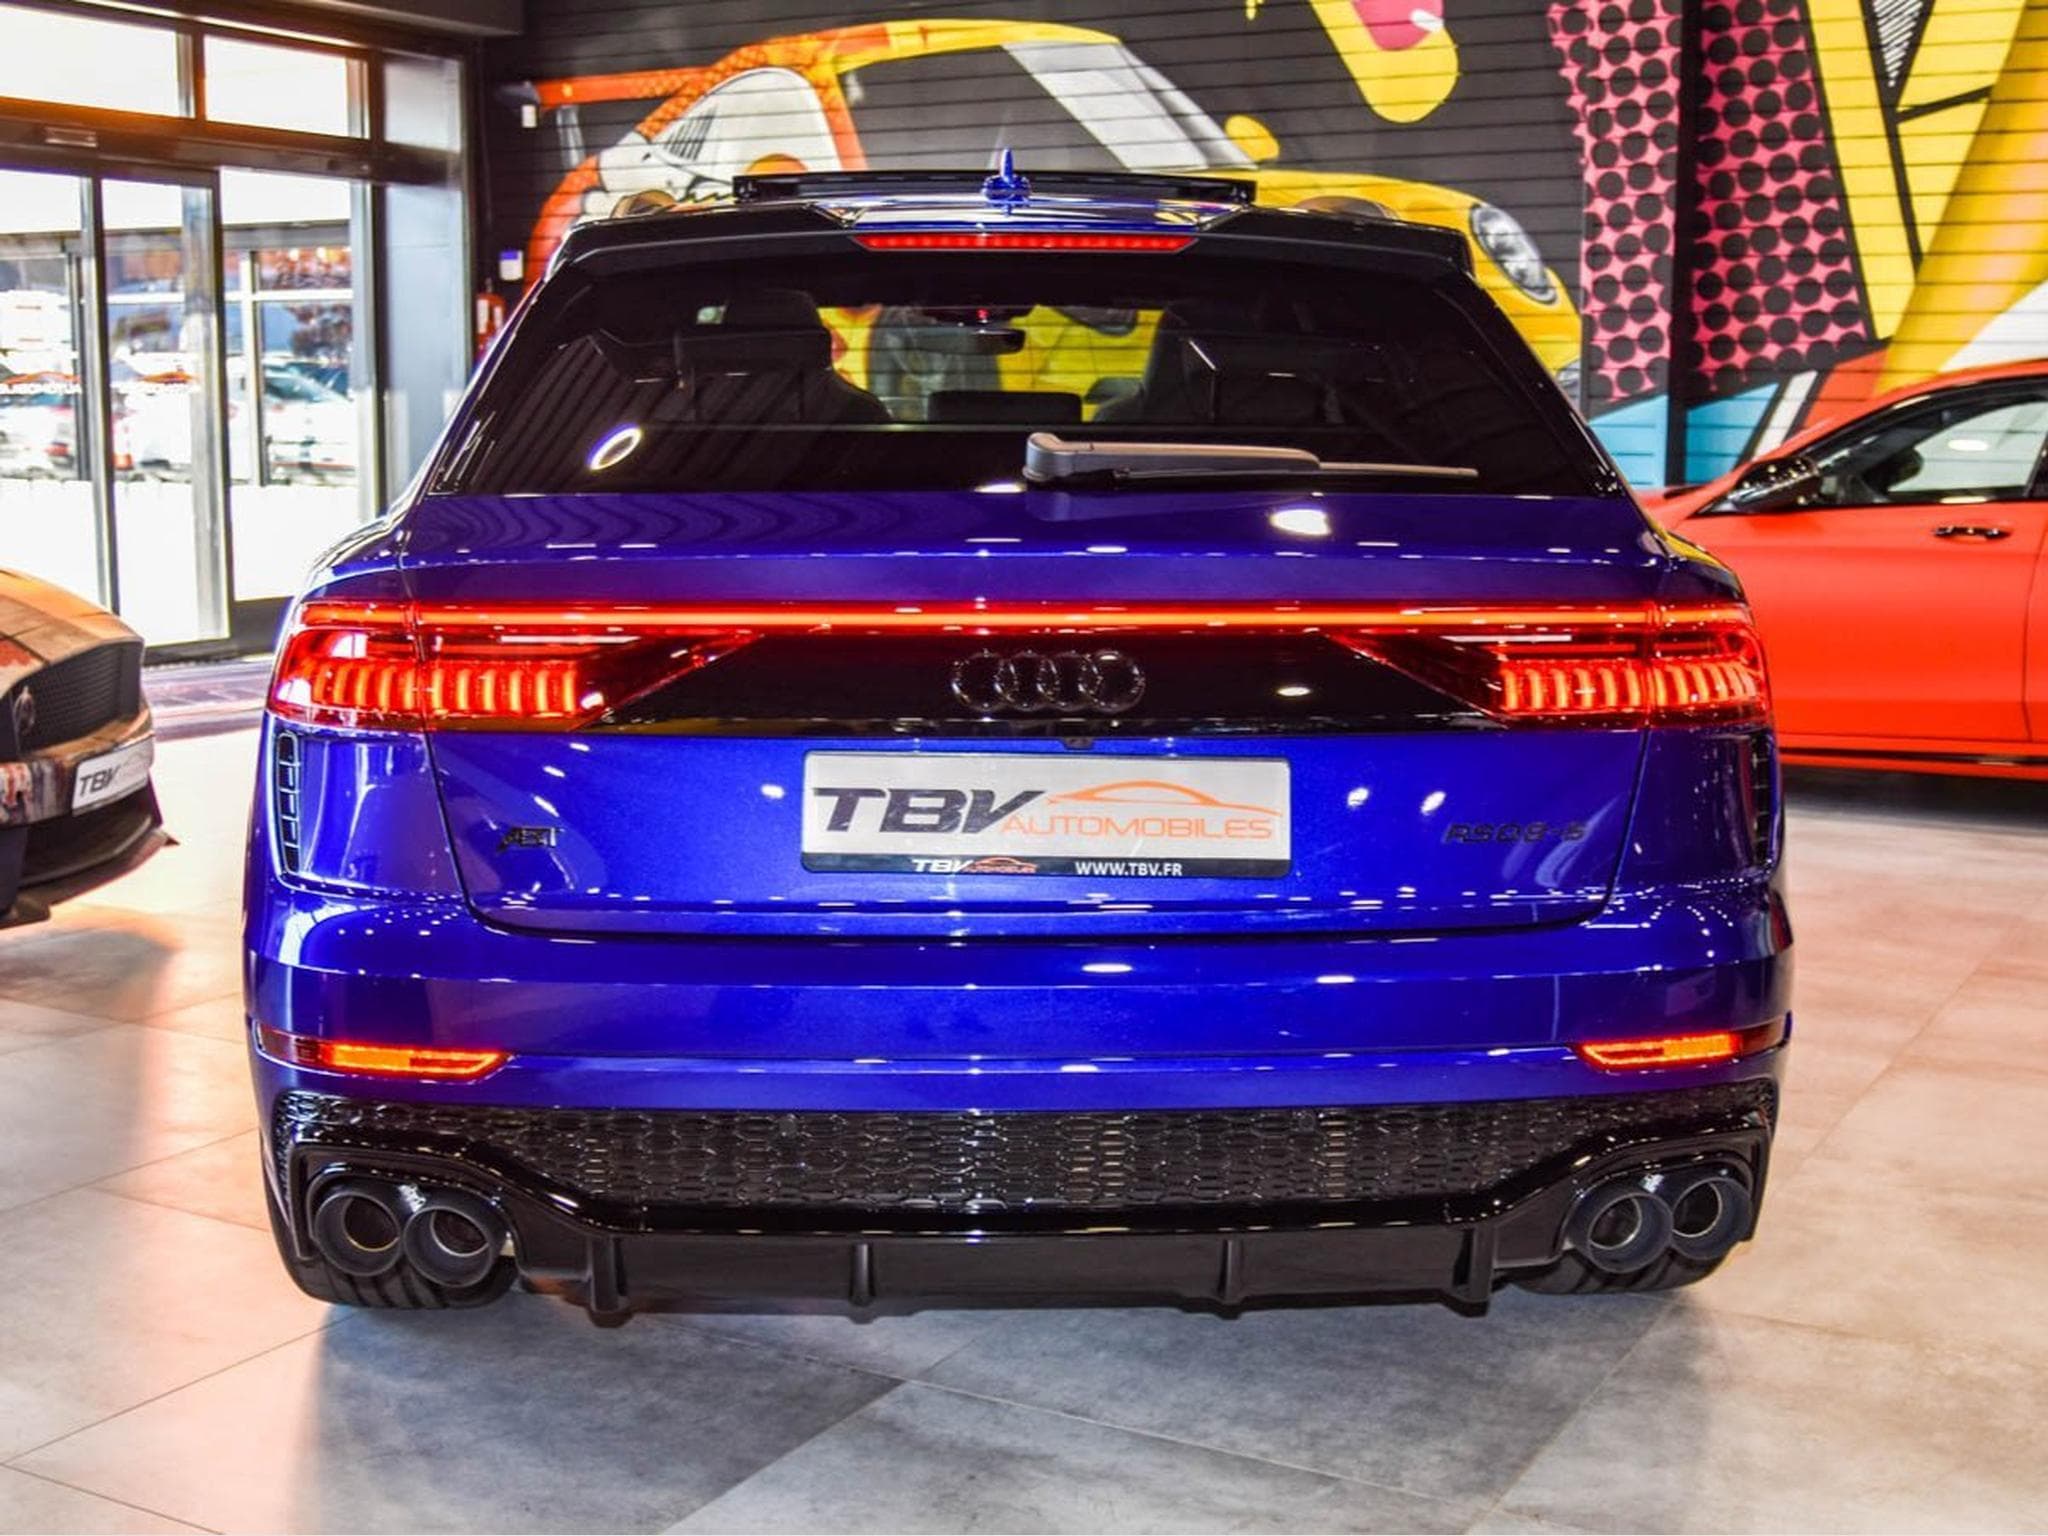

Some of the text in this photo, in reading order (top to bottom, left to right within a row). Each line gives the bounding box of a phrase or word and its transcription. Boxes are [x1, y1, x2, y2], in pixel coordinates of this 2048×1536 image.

[79, 764, 121, 798] TBV
[811, 787, 1273, 840] TBV AUTOMOBILES
[911, 858, 974, 873] TBV
[1075, 861, 1183, 877] WWW.TBV.FR
